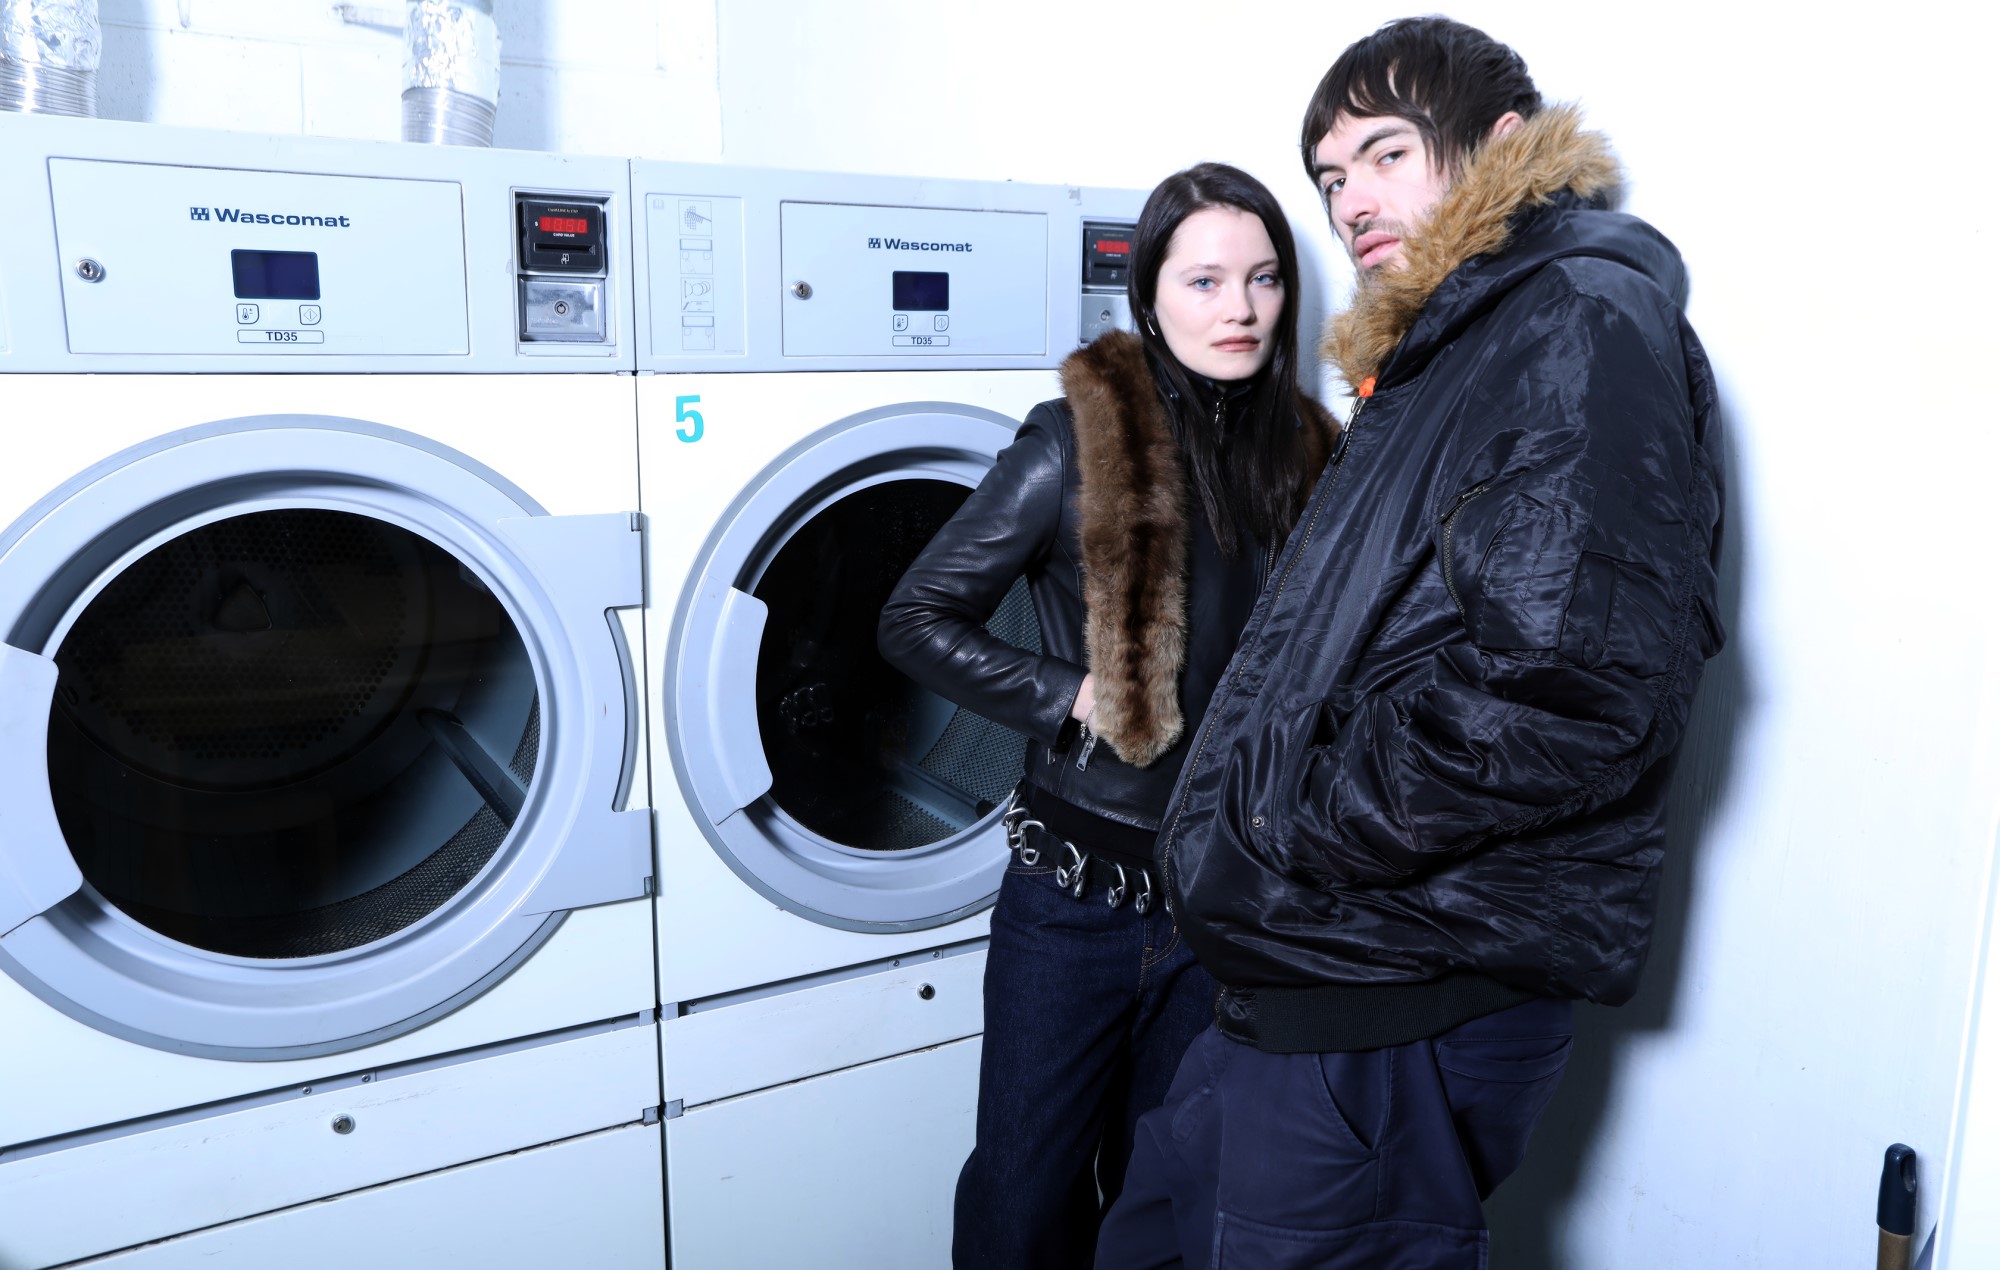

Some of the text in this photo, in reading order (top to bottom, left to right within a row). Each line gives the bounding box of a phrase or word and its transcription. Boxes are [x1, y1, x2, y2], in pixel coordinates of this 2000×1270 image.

[214, 207, 350, 227] Wascomat
[884, 238, 973, 252] Wascomat
[265, 331, 298, 342] TD35
[911, 336, 933, 345] TD35
[676, 394, 705, 443] 5
